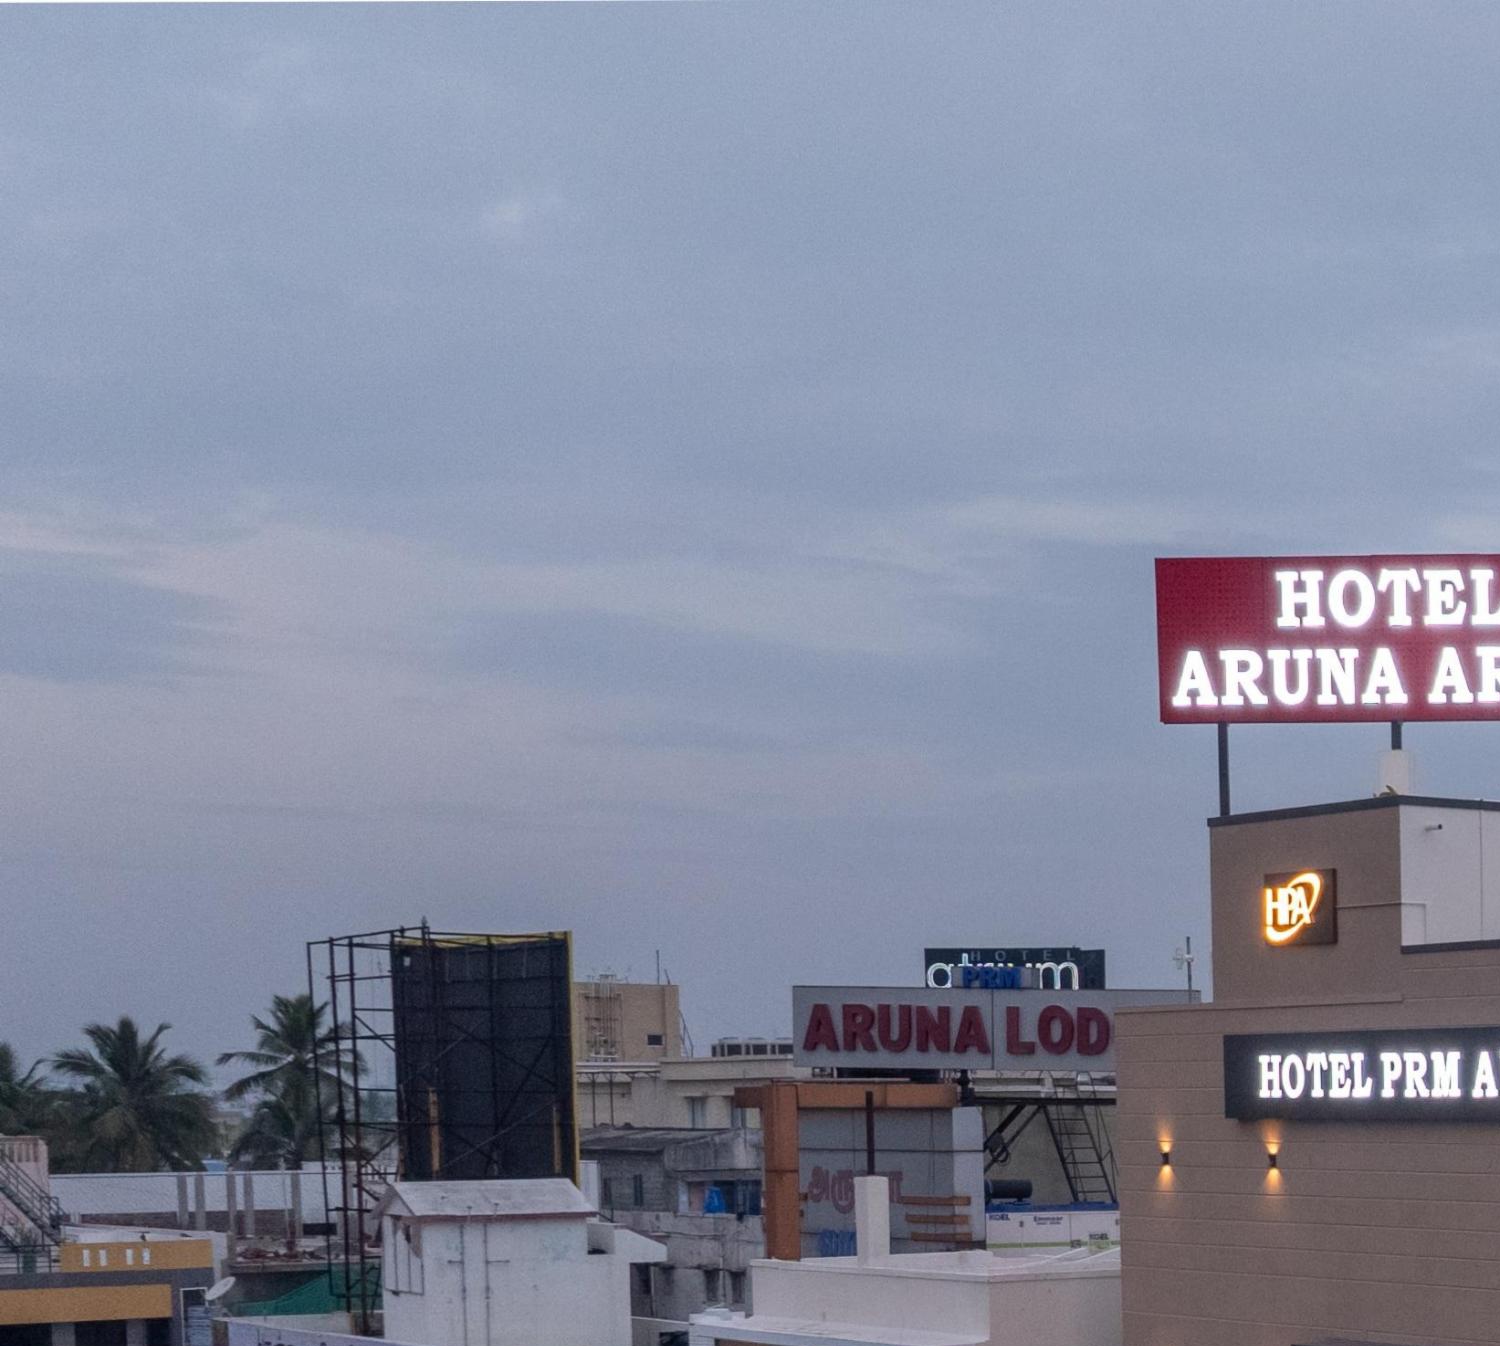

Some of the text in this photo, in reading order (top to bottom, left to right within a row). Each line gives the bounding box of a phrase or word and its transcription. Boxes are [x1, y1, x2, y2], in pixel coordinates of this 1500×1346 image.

[1173, 647, 1408, 706] ARUNA
[970, 949, 1076, 962] HOTEL
[802, 1003, 992, 1055] ARUNA
[1258, 1052, 1373, 1099] HOTEL
[1380, 1051, 1462, 1098] PRM
